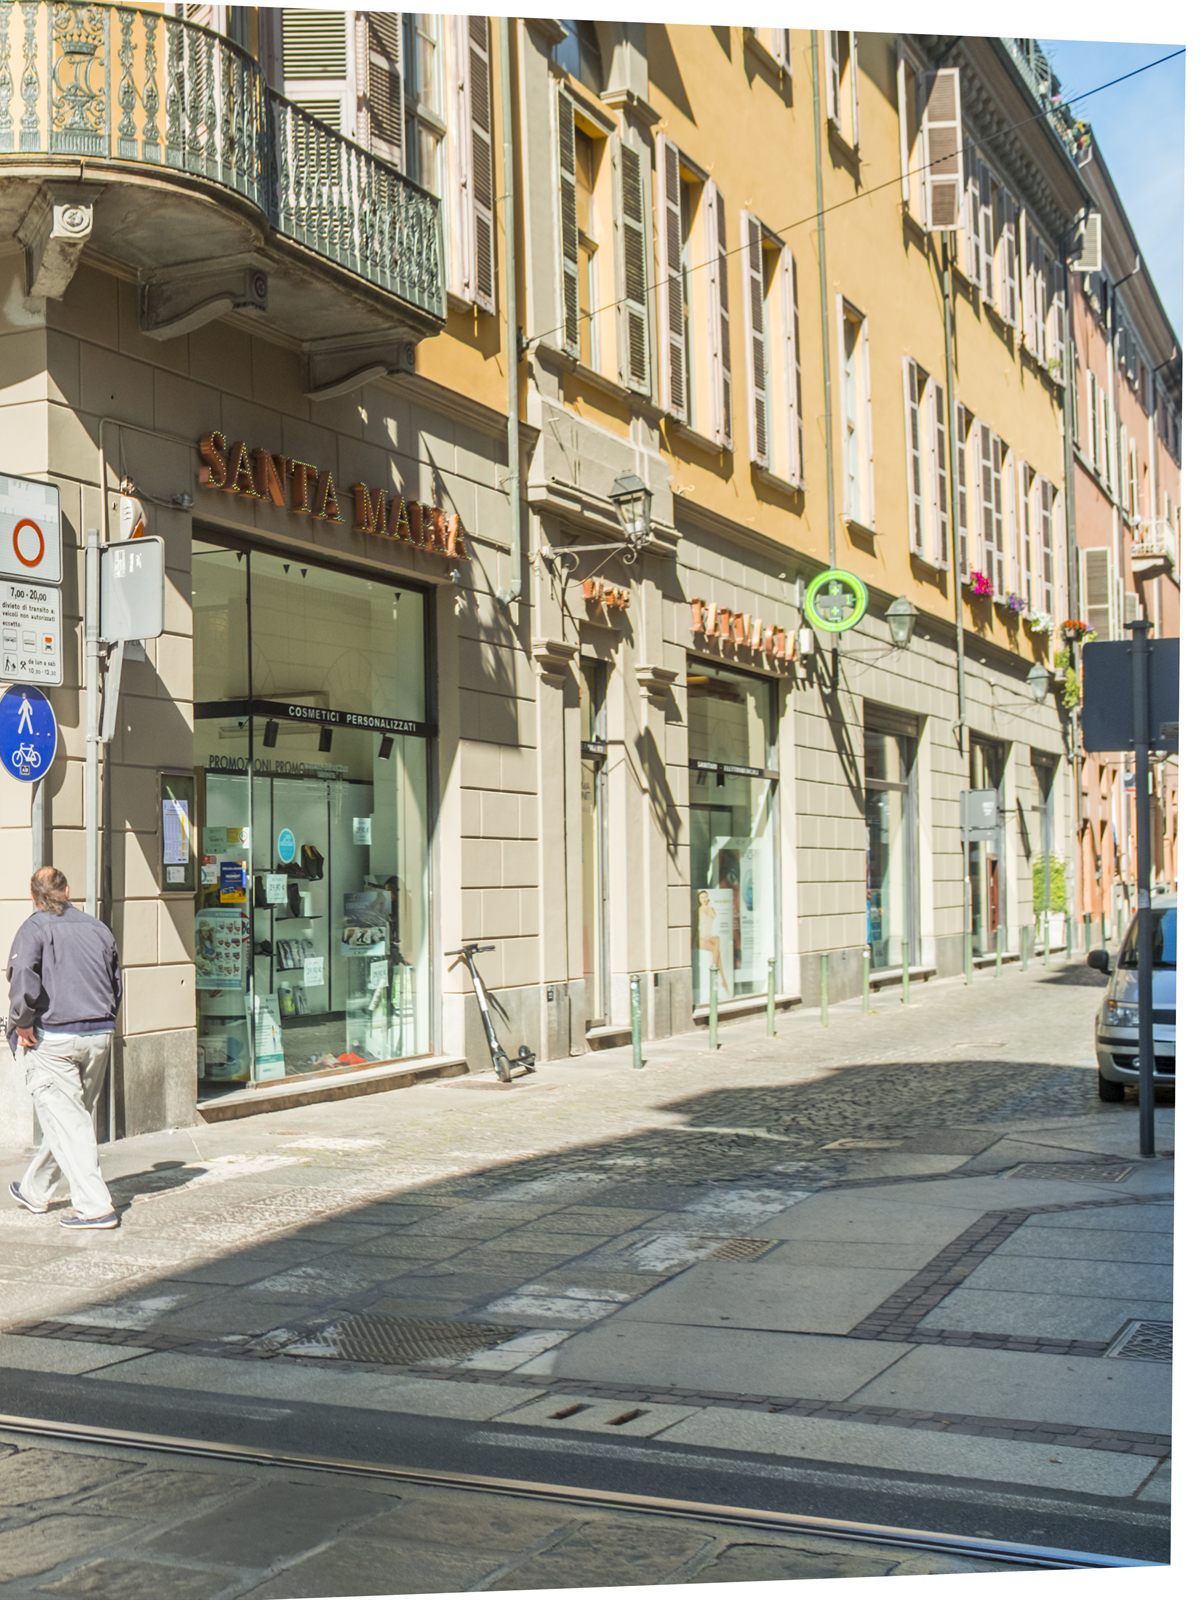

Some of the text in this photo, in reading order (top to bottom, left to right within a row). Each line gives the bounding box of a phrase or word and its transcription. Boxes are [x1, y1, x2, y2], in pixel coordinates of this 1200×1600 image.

[198, 431, 472, 560] SANTA MARIA
[11, 587, 25, 599] 7,00
[30, 590, 47, 602] 20,00
[2, 602, 20, 610] divieto
[288, 706, 416, 732] COSMETICI PERSONALIZZATI
